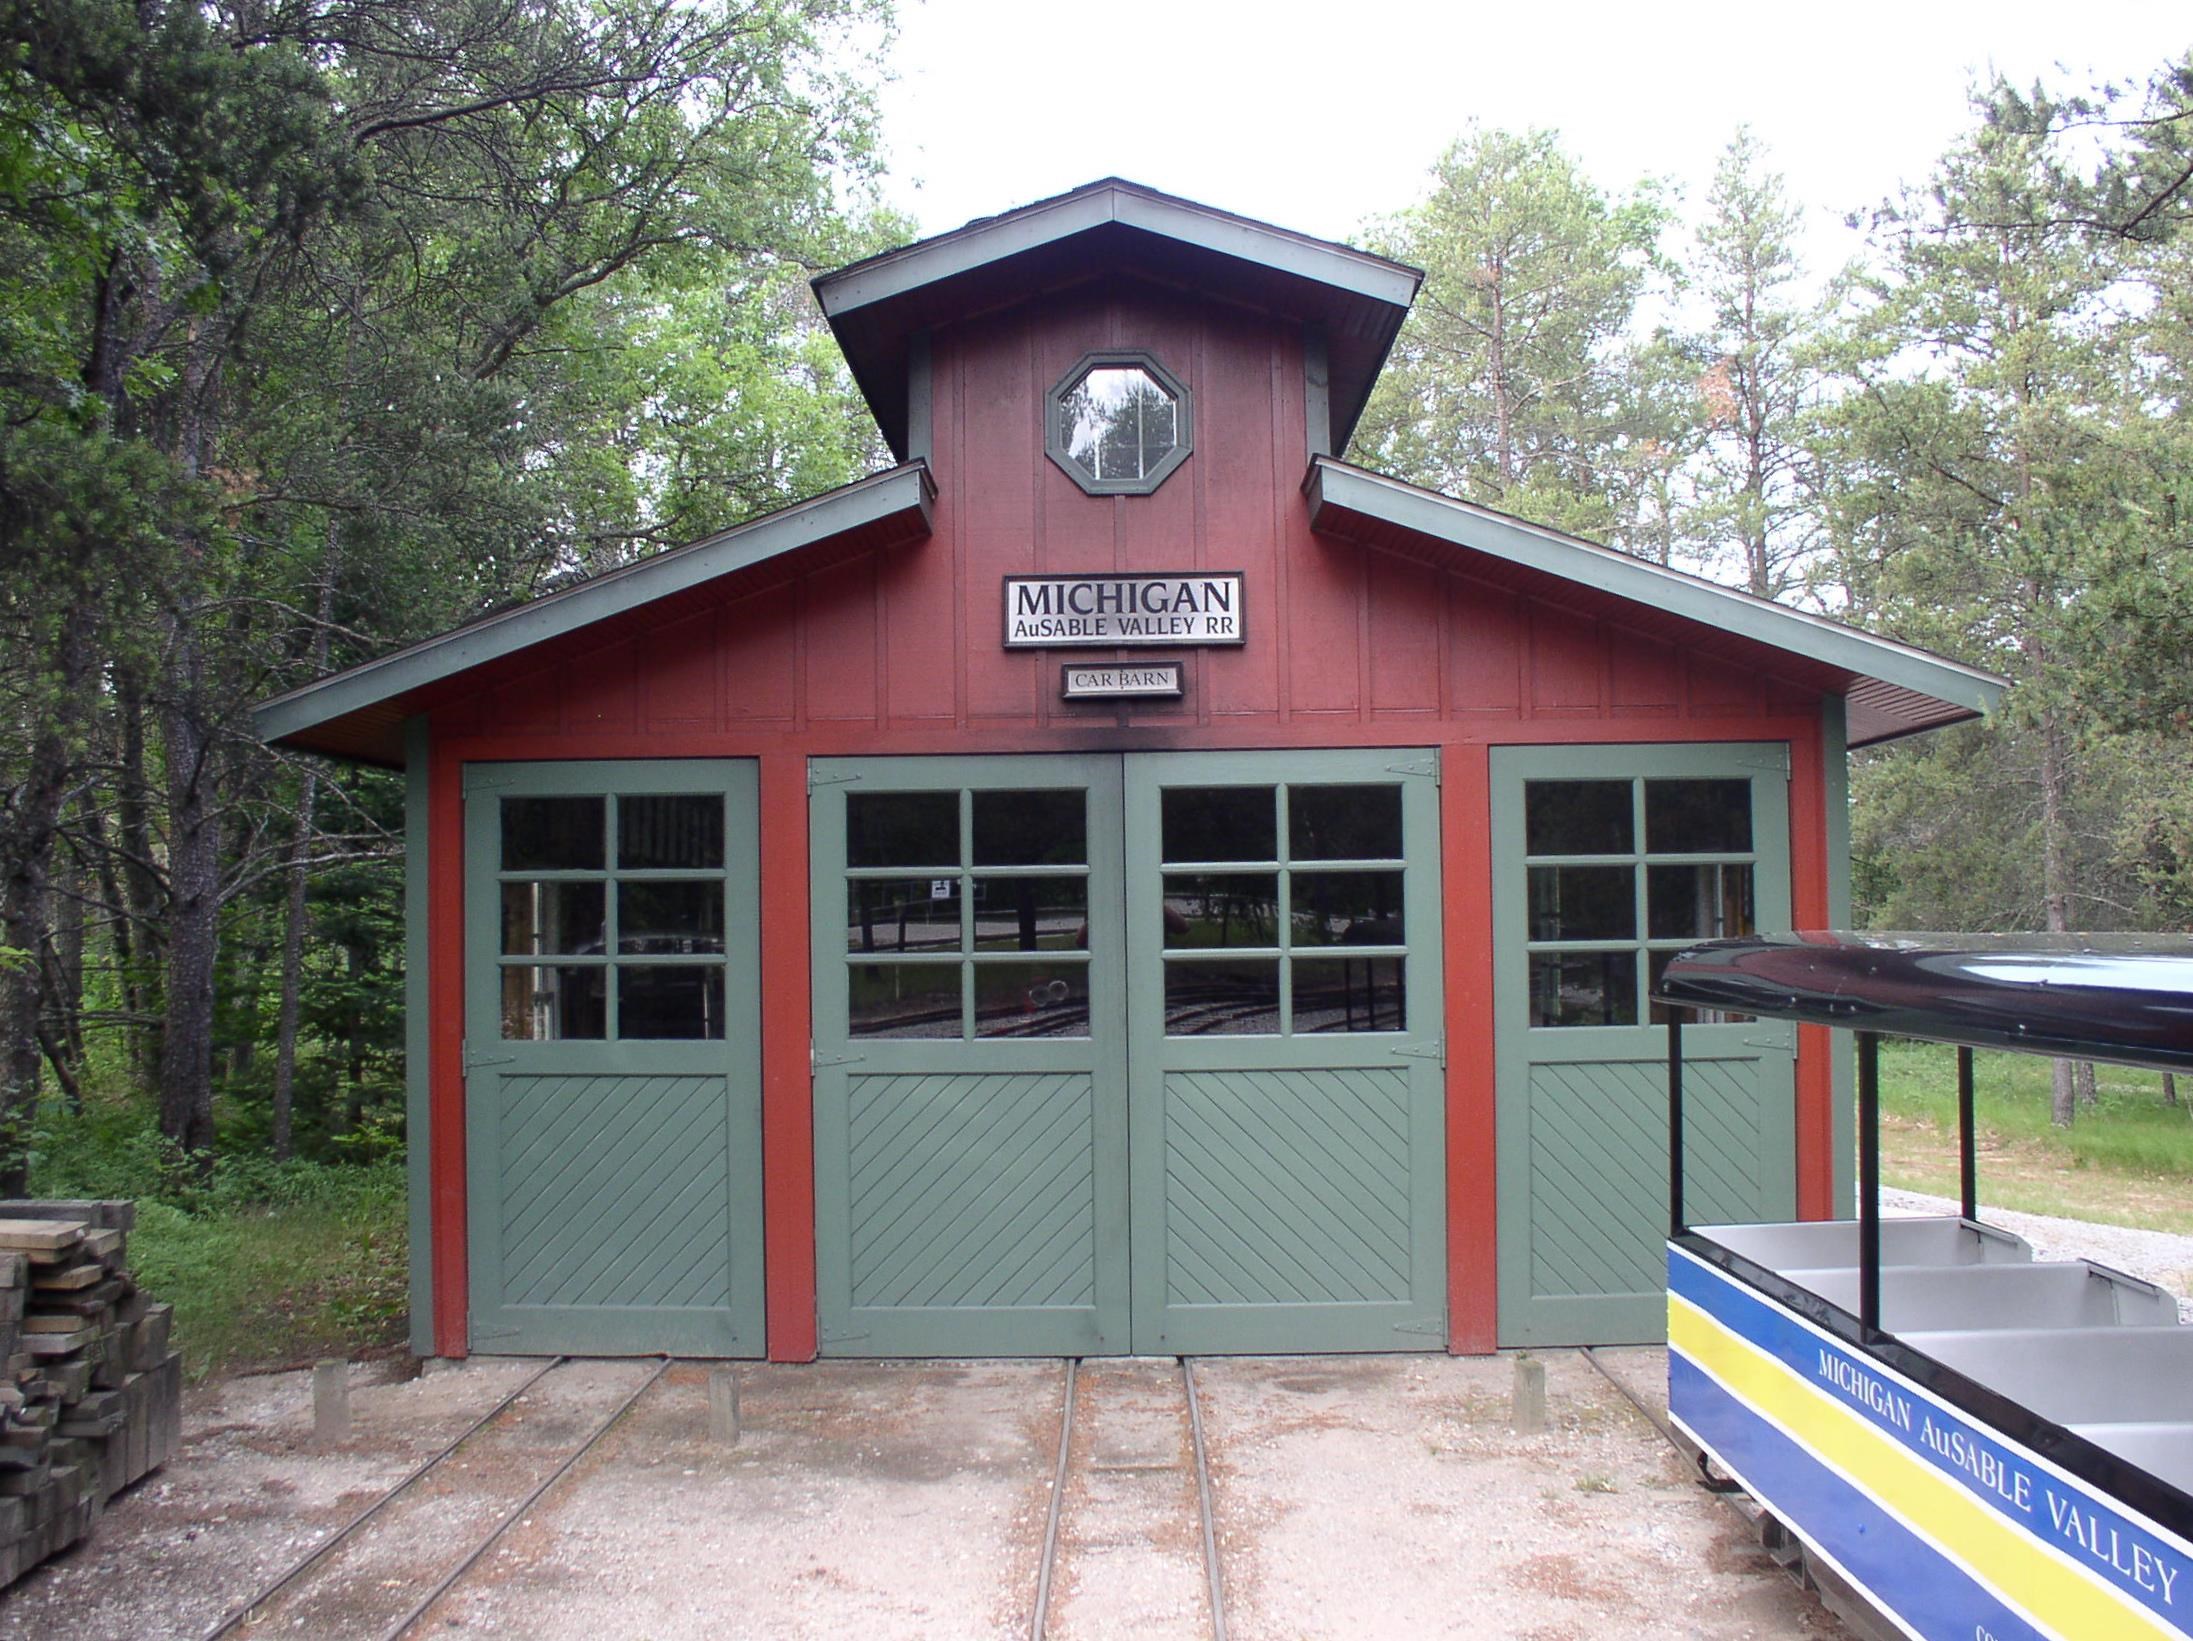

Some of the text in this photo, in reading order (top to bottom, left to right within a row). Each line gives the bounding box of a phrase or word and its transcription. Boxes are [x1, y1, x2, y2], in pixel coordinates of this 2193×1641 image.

[1016, 581, 1231, 616] MICHIGAN
[1013, 616, 1234, 638] AuSABLE VALLEY RR
[1074, 671, 1170, 687] CAR BARN
[1818, 1348, 2178, 1606] MICHIGAN AuSABLE VALLEY
